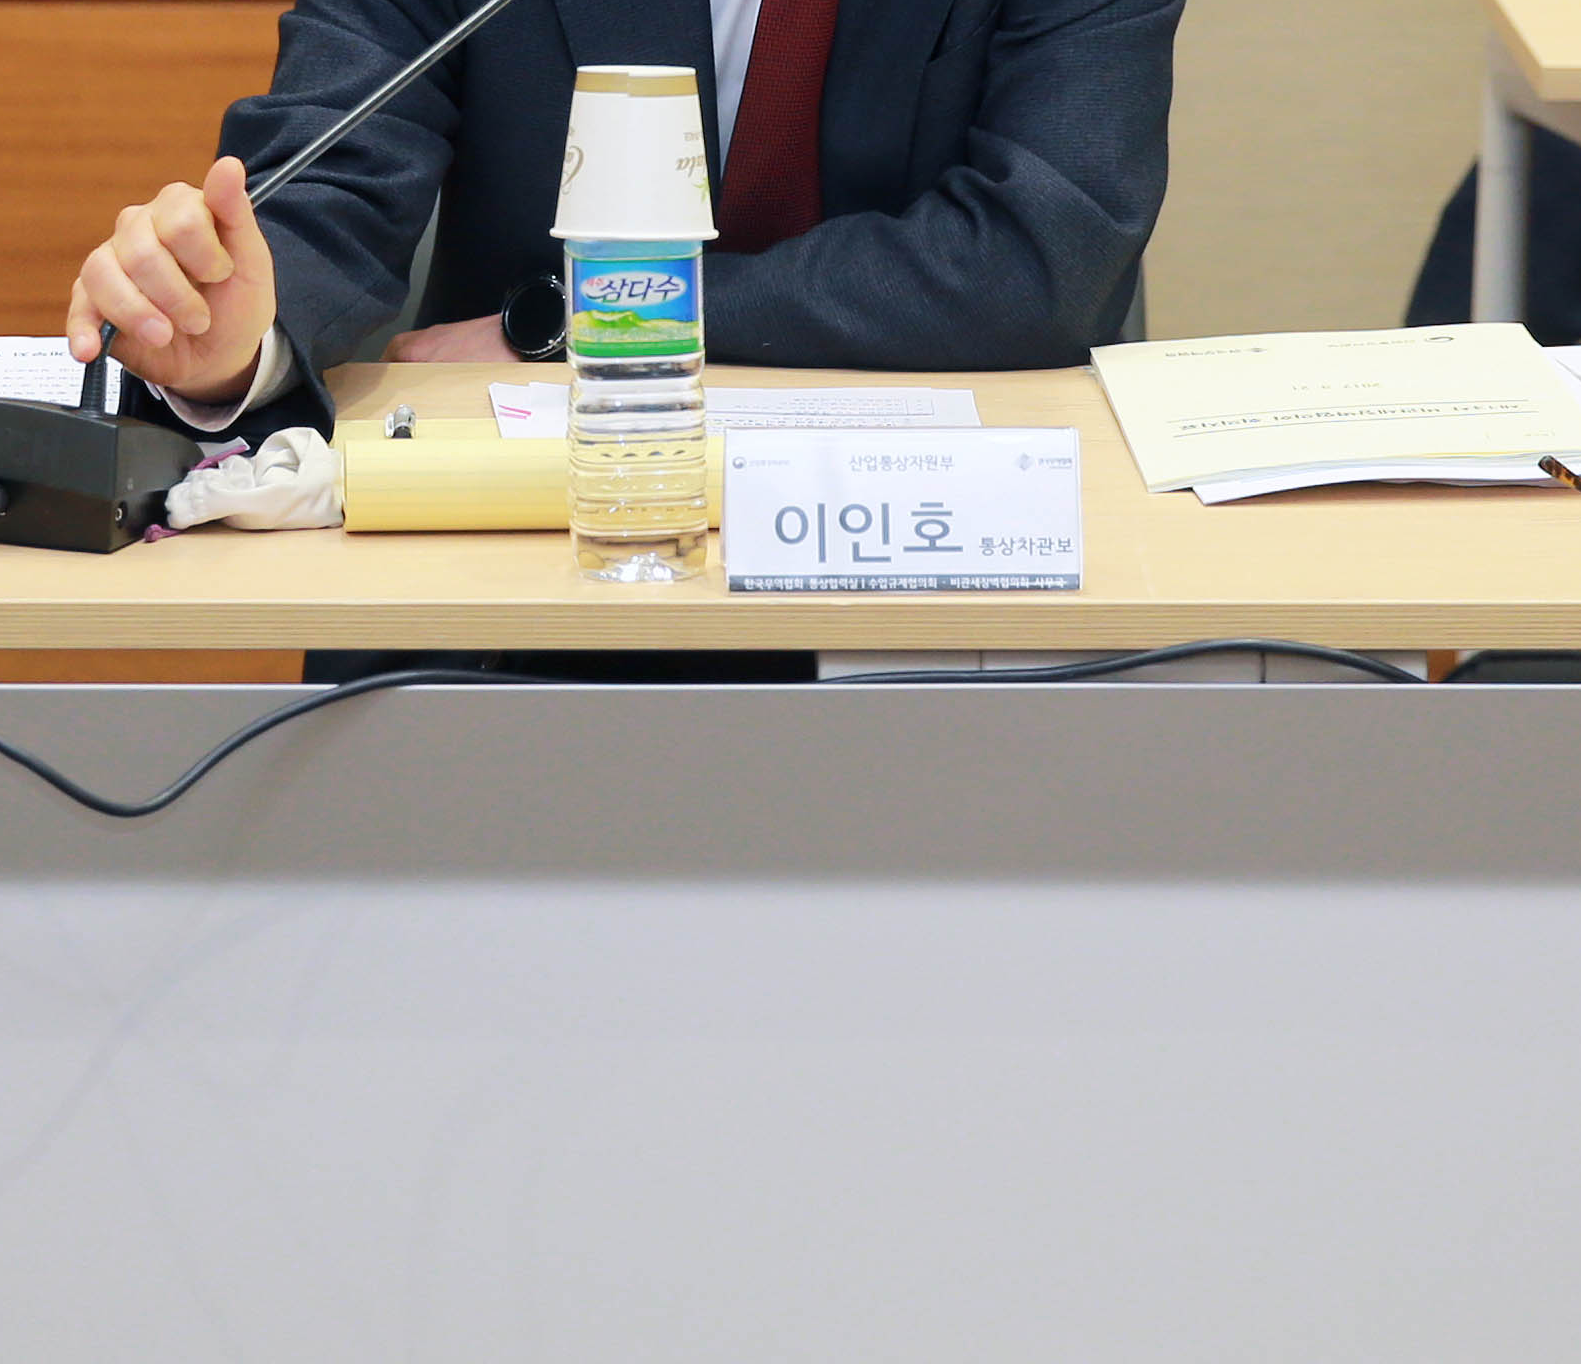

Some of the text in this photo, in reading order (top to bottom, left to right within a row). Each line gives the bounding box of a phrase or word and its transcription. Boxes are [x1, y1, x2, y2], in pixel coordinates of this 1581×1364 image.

[587, 275, 680, 303] 삼다수
[849, 454, 955, 472] 산업통상자원부
[774, 502, 1075, 564] 이인호 통상차관보
